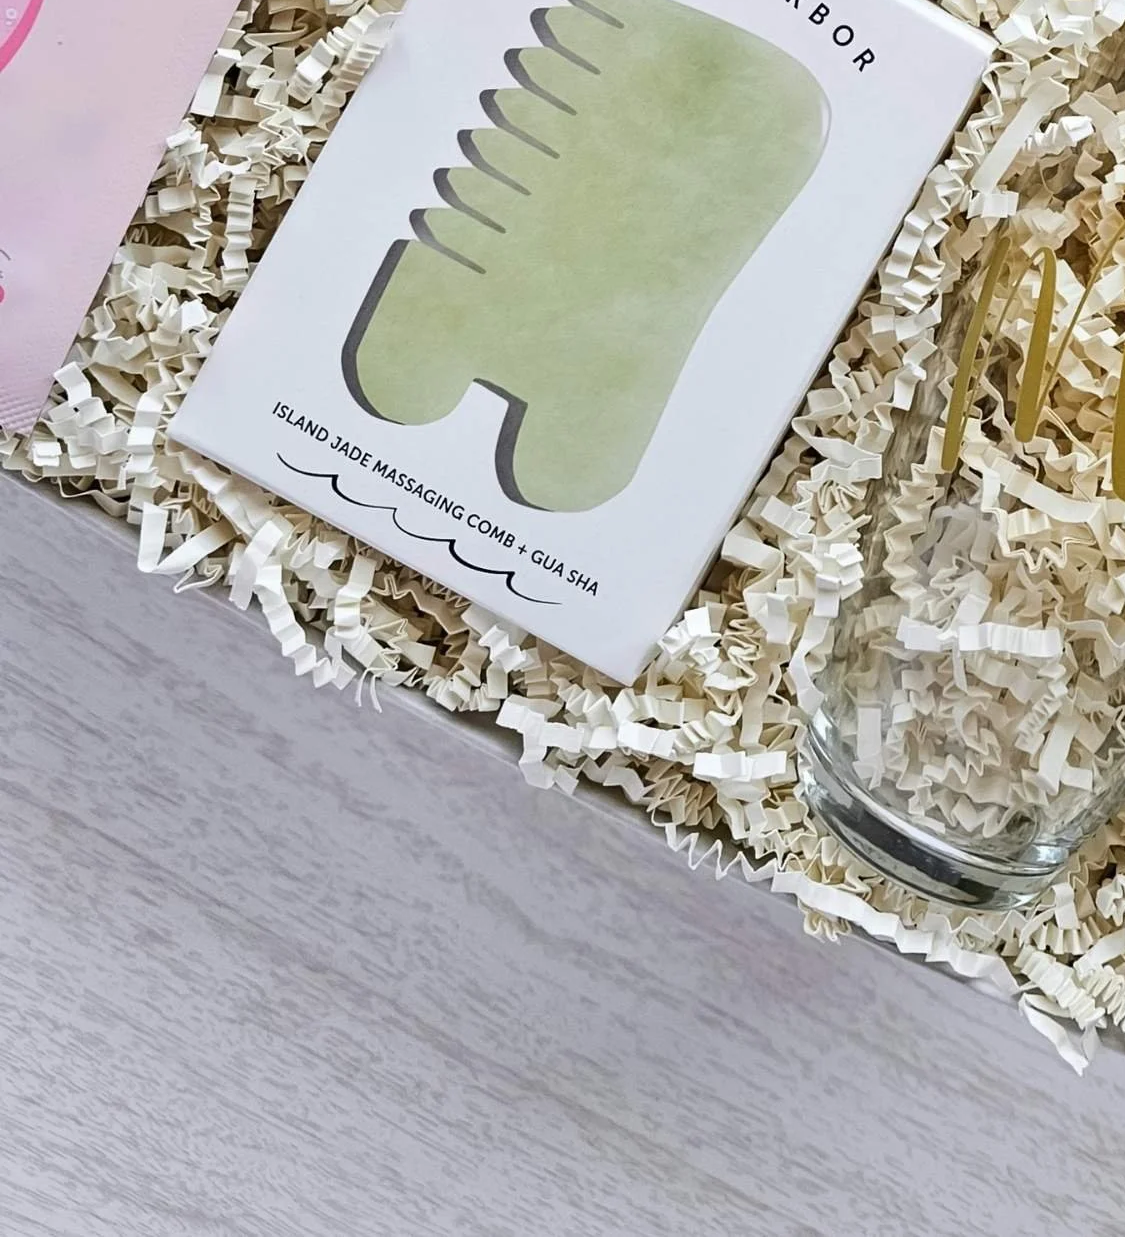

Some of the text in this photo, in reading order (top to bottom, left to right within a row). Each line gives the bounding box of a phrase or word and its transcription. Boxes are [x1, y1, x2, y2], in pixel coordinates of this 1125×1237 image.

[272, 401, 328, 442] ISLAND
[330, 435, 373, 468] JADE
[372, 459, 464, 520] MASSAGING
[466, 513, 515, 548] COMB
[531, 549, 564, 578] GUA
[566, 569, 599, 597] SHA
